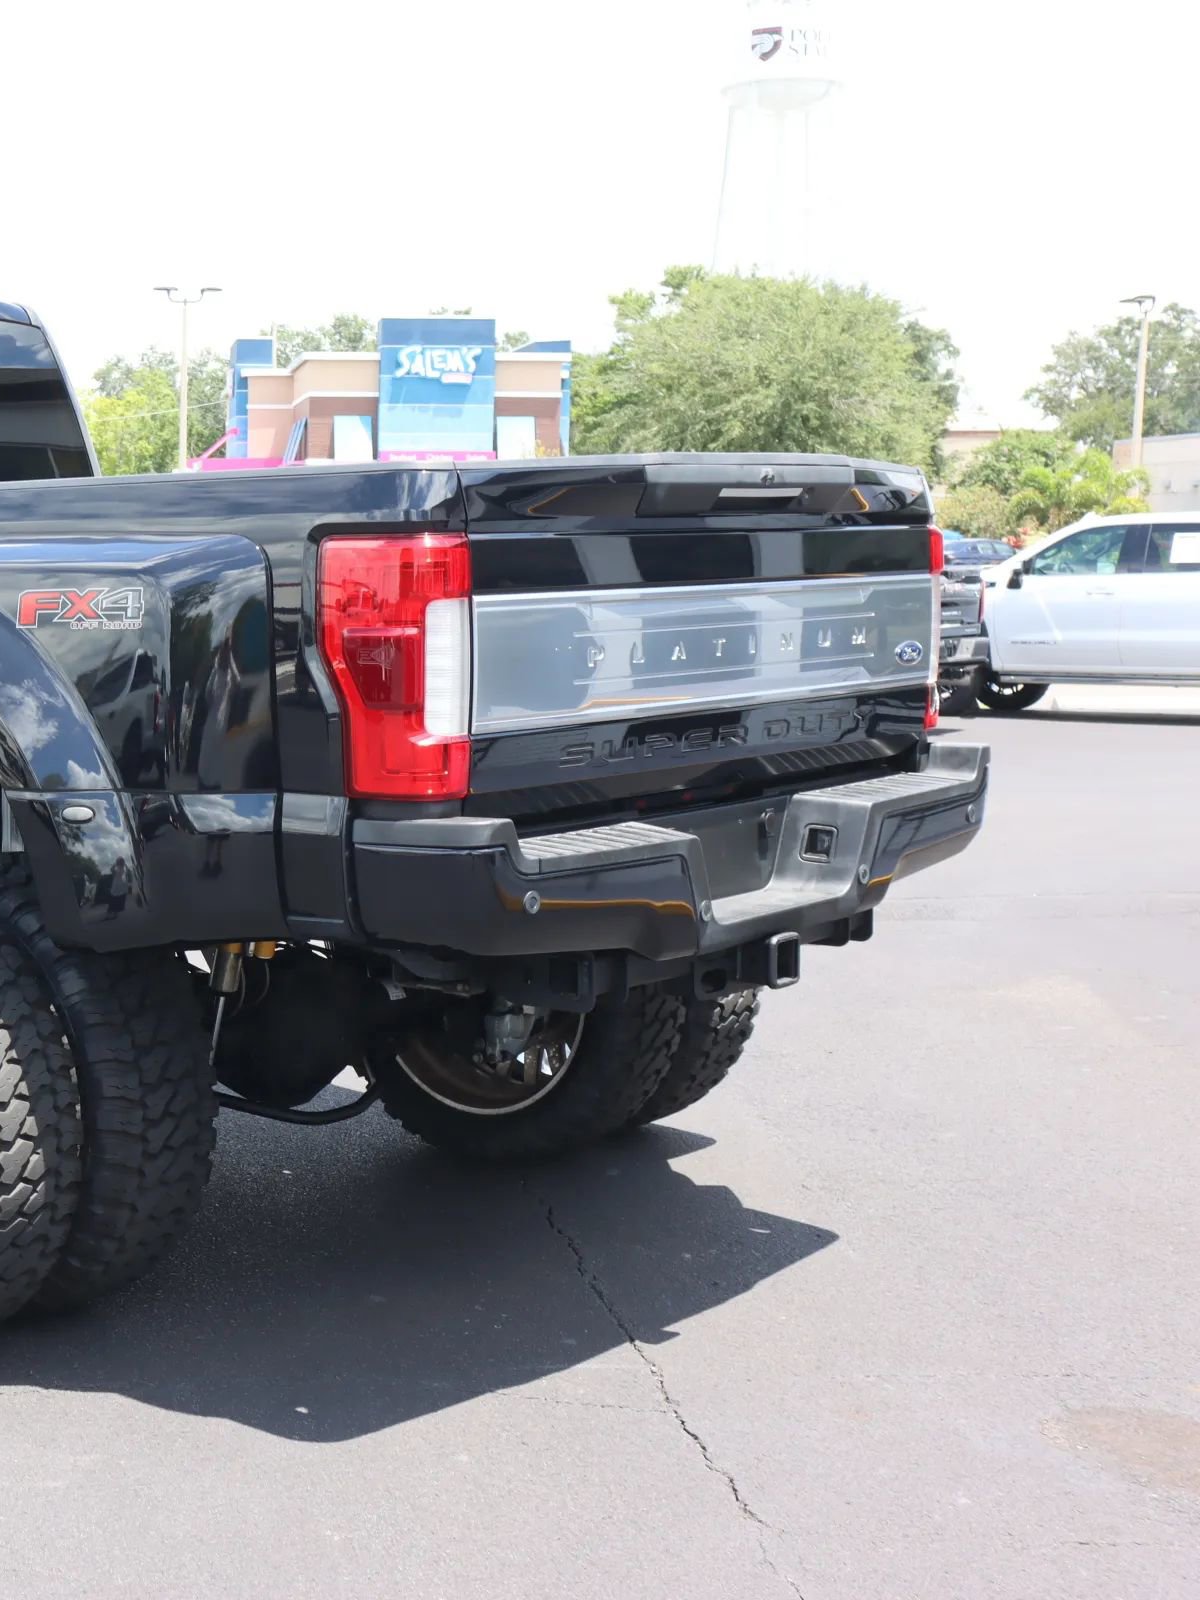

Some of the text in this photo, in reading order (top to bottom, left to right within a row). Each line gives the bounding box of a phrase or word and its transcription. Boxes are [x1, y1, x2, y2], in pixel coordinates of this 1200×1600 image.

[16, 587, 144, 628] FX4
[70, 621, 143, 630] OFF ROAD
[586, 625, 868, 668] PLATINUM
[557, 708, 874, 769] SUPER DUTY
